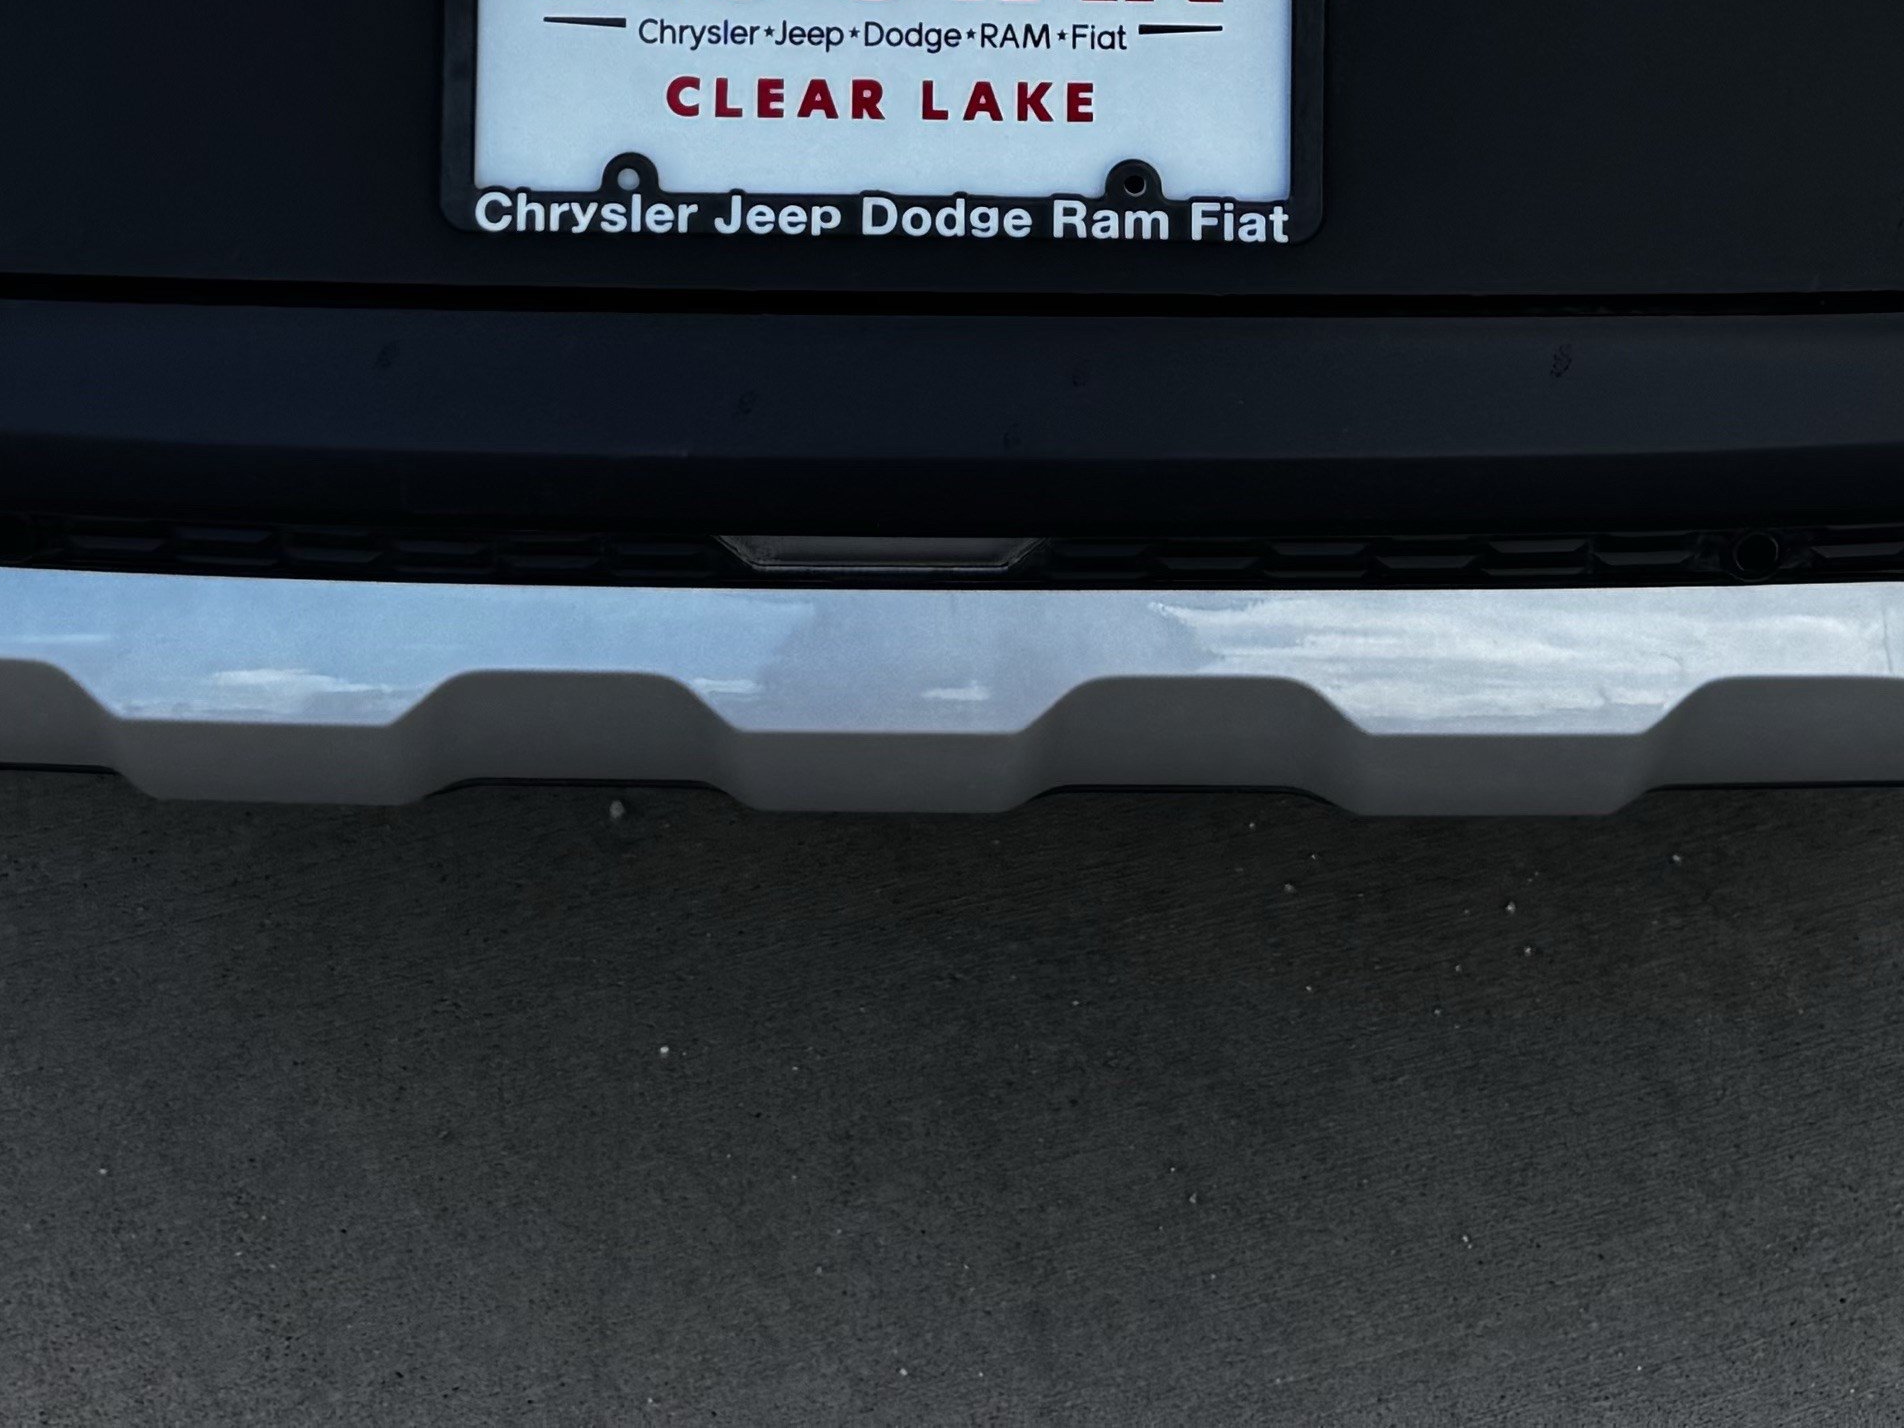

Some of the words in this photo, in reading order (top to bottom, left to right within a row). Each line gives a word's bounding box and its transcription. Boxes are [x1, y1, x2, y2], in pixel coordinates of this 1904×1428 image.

[638, 17, 759, 52] Chrysler
[775, 18, 844, 53] Jeep
[864, 20, 960, 55] Dodge
[981, 23, 1051, 49] RAM
[1071, 23, 1127, 51] Fiat
[666, 76, 884, 121] CLEAR
[921, 79, 1095, 124] LAKE
[475, 191, 698, 234] Chrysler
[715, 195, 841, 236] Jeep
[862, 197, 1031, 239] Dodge
[1053, 200, 1168, 240] Ram
[1192, 201, 1289, 244] Fiat
